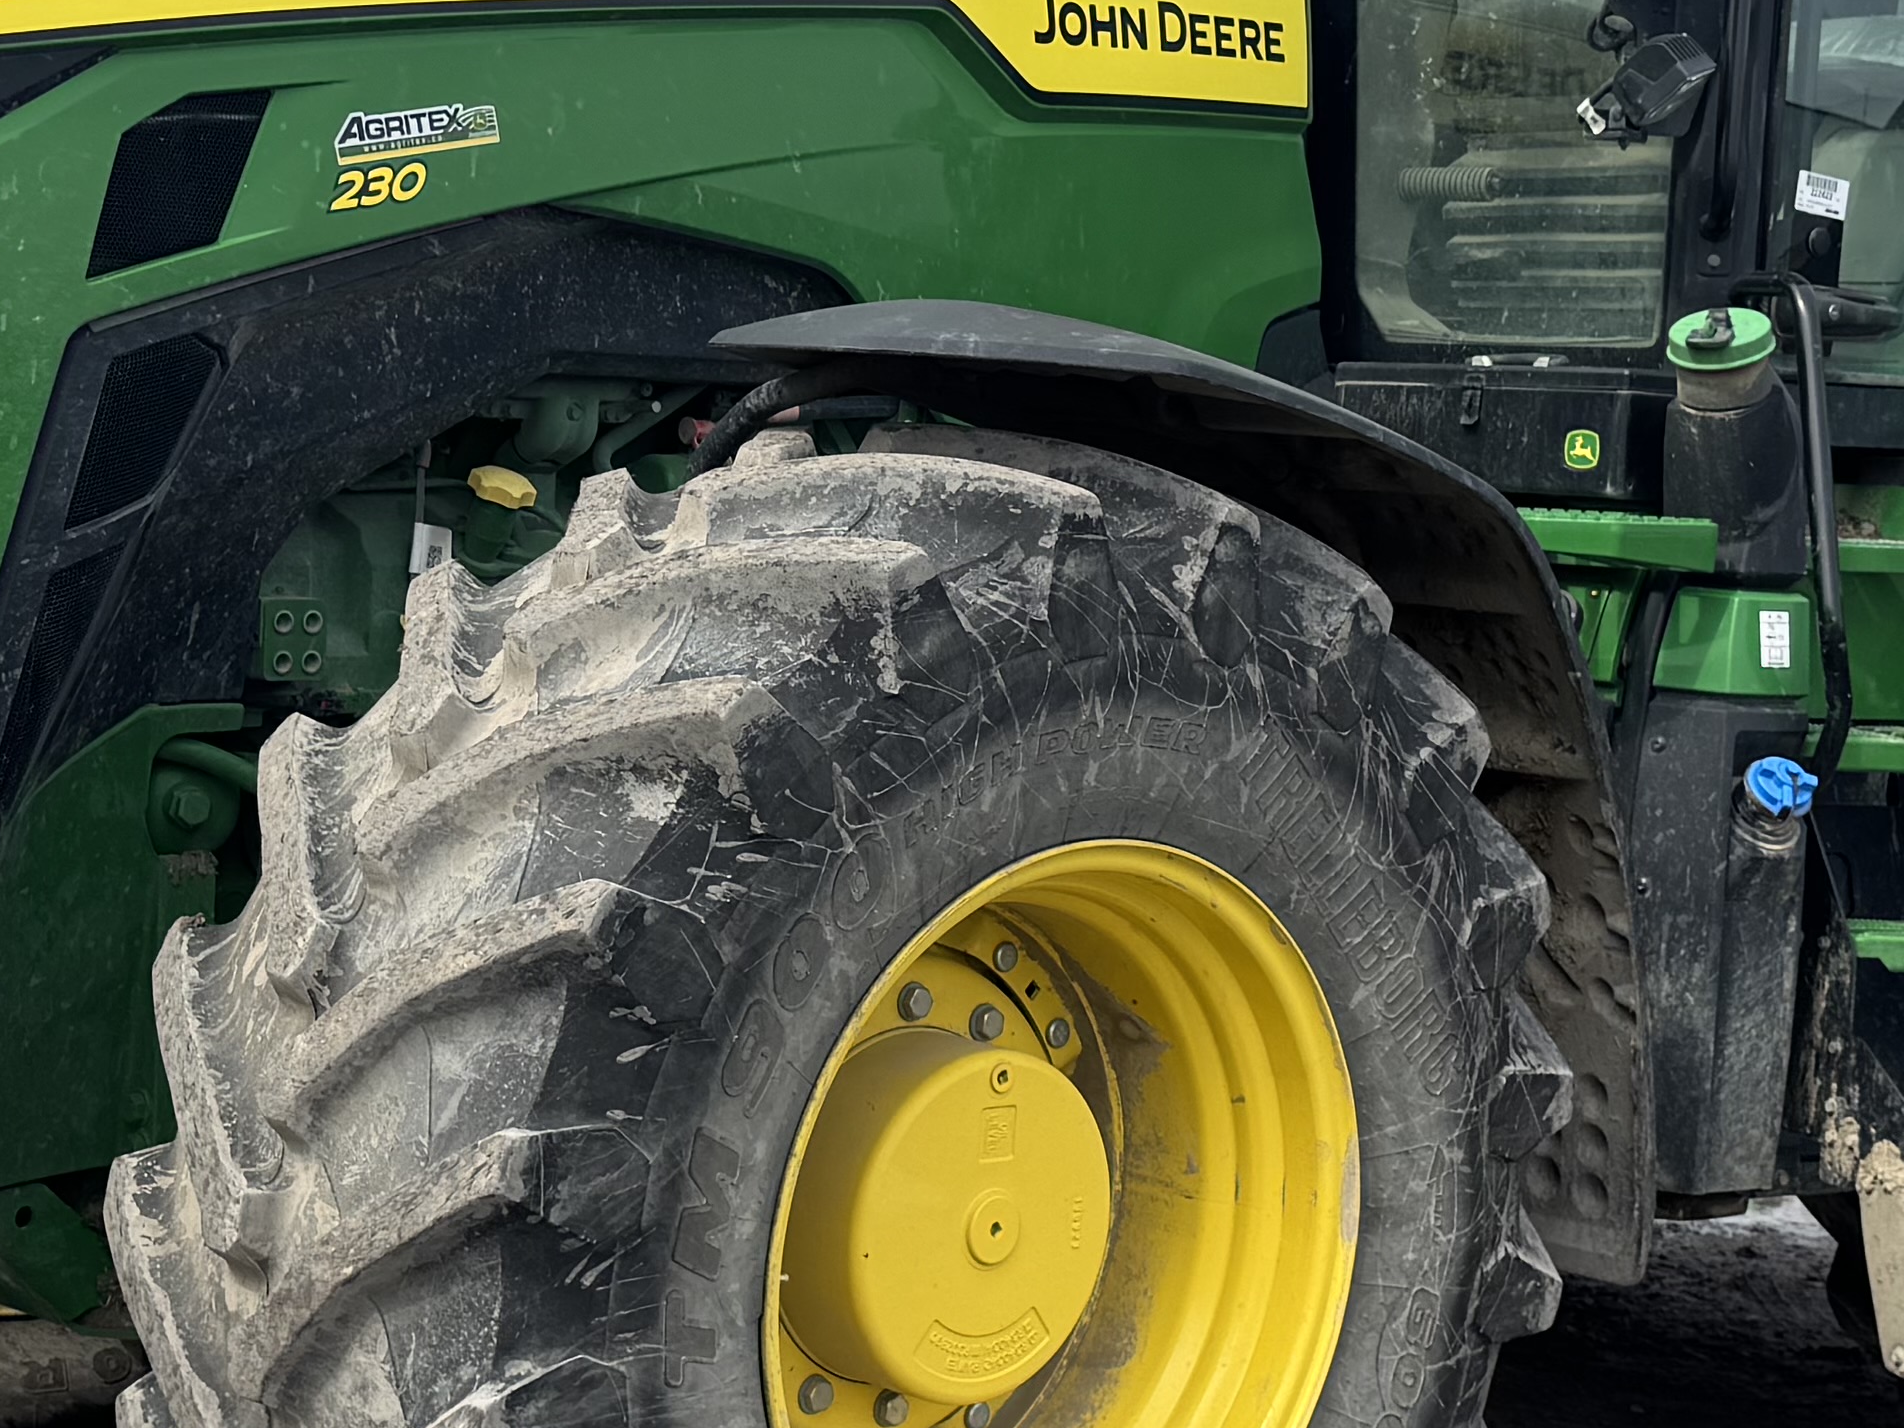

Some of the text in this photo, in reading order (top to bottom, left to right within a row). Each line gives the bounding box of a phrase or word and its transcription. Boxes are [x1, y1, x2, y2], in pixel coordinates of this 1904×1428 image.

[1157, 0, 1286, 63] DEERE
[338, 107, 464, 145] AGRITEX
[329, 161, 428, 212] 230
[1239, 718, 1464, 1097] TRELLEBORG
